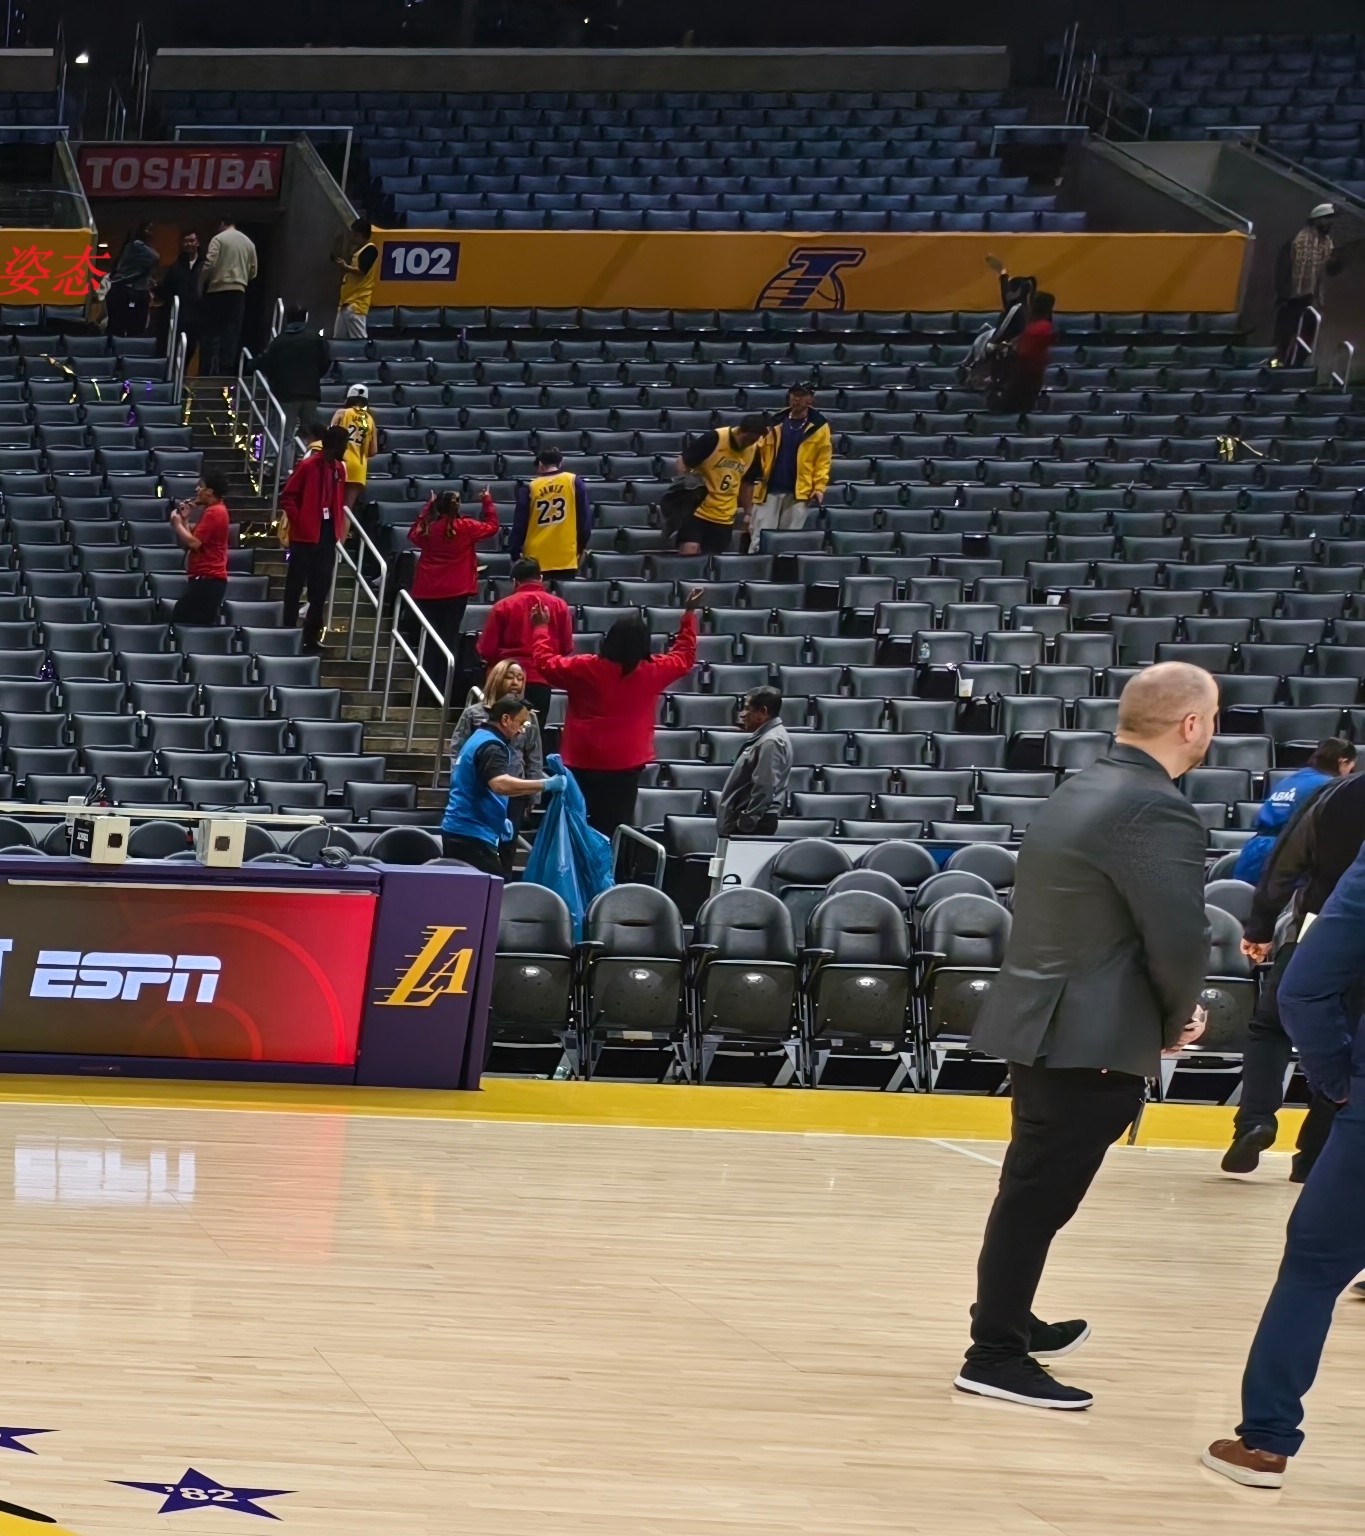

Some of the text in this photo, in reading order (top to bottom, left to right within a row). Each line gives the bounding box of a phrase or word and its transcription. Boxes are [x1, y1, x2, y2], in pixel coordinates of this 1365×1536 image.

[85, 156, 275, 191] TOSHIBA
[390, 246, 452, 275] 102
[538, 483, 564, 497] JAMES
[720, 474, 732, 492] 6
[535, 497, 568, 526] 23
[1269, 791, 1296, 802] ABM
[29, 950, 222, 1003] ESPN
[373, 925, 475, 1008] LA
[165, 1485, 240, 1504] '82
